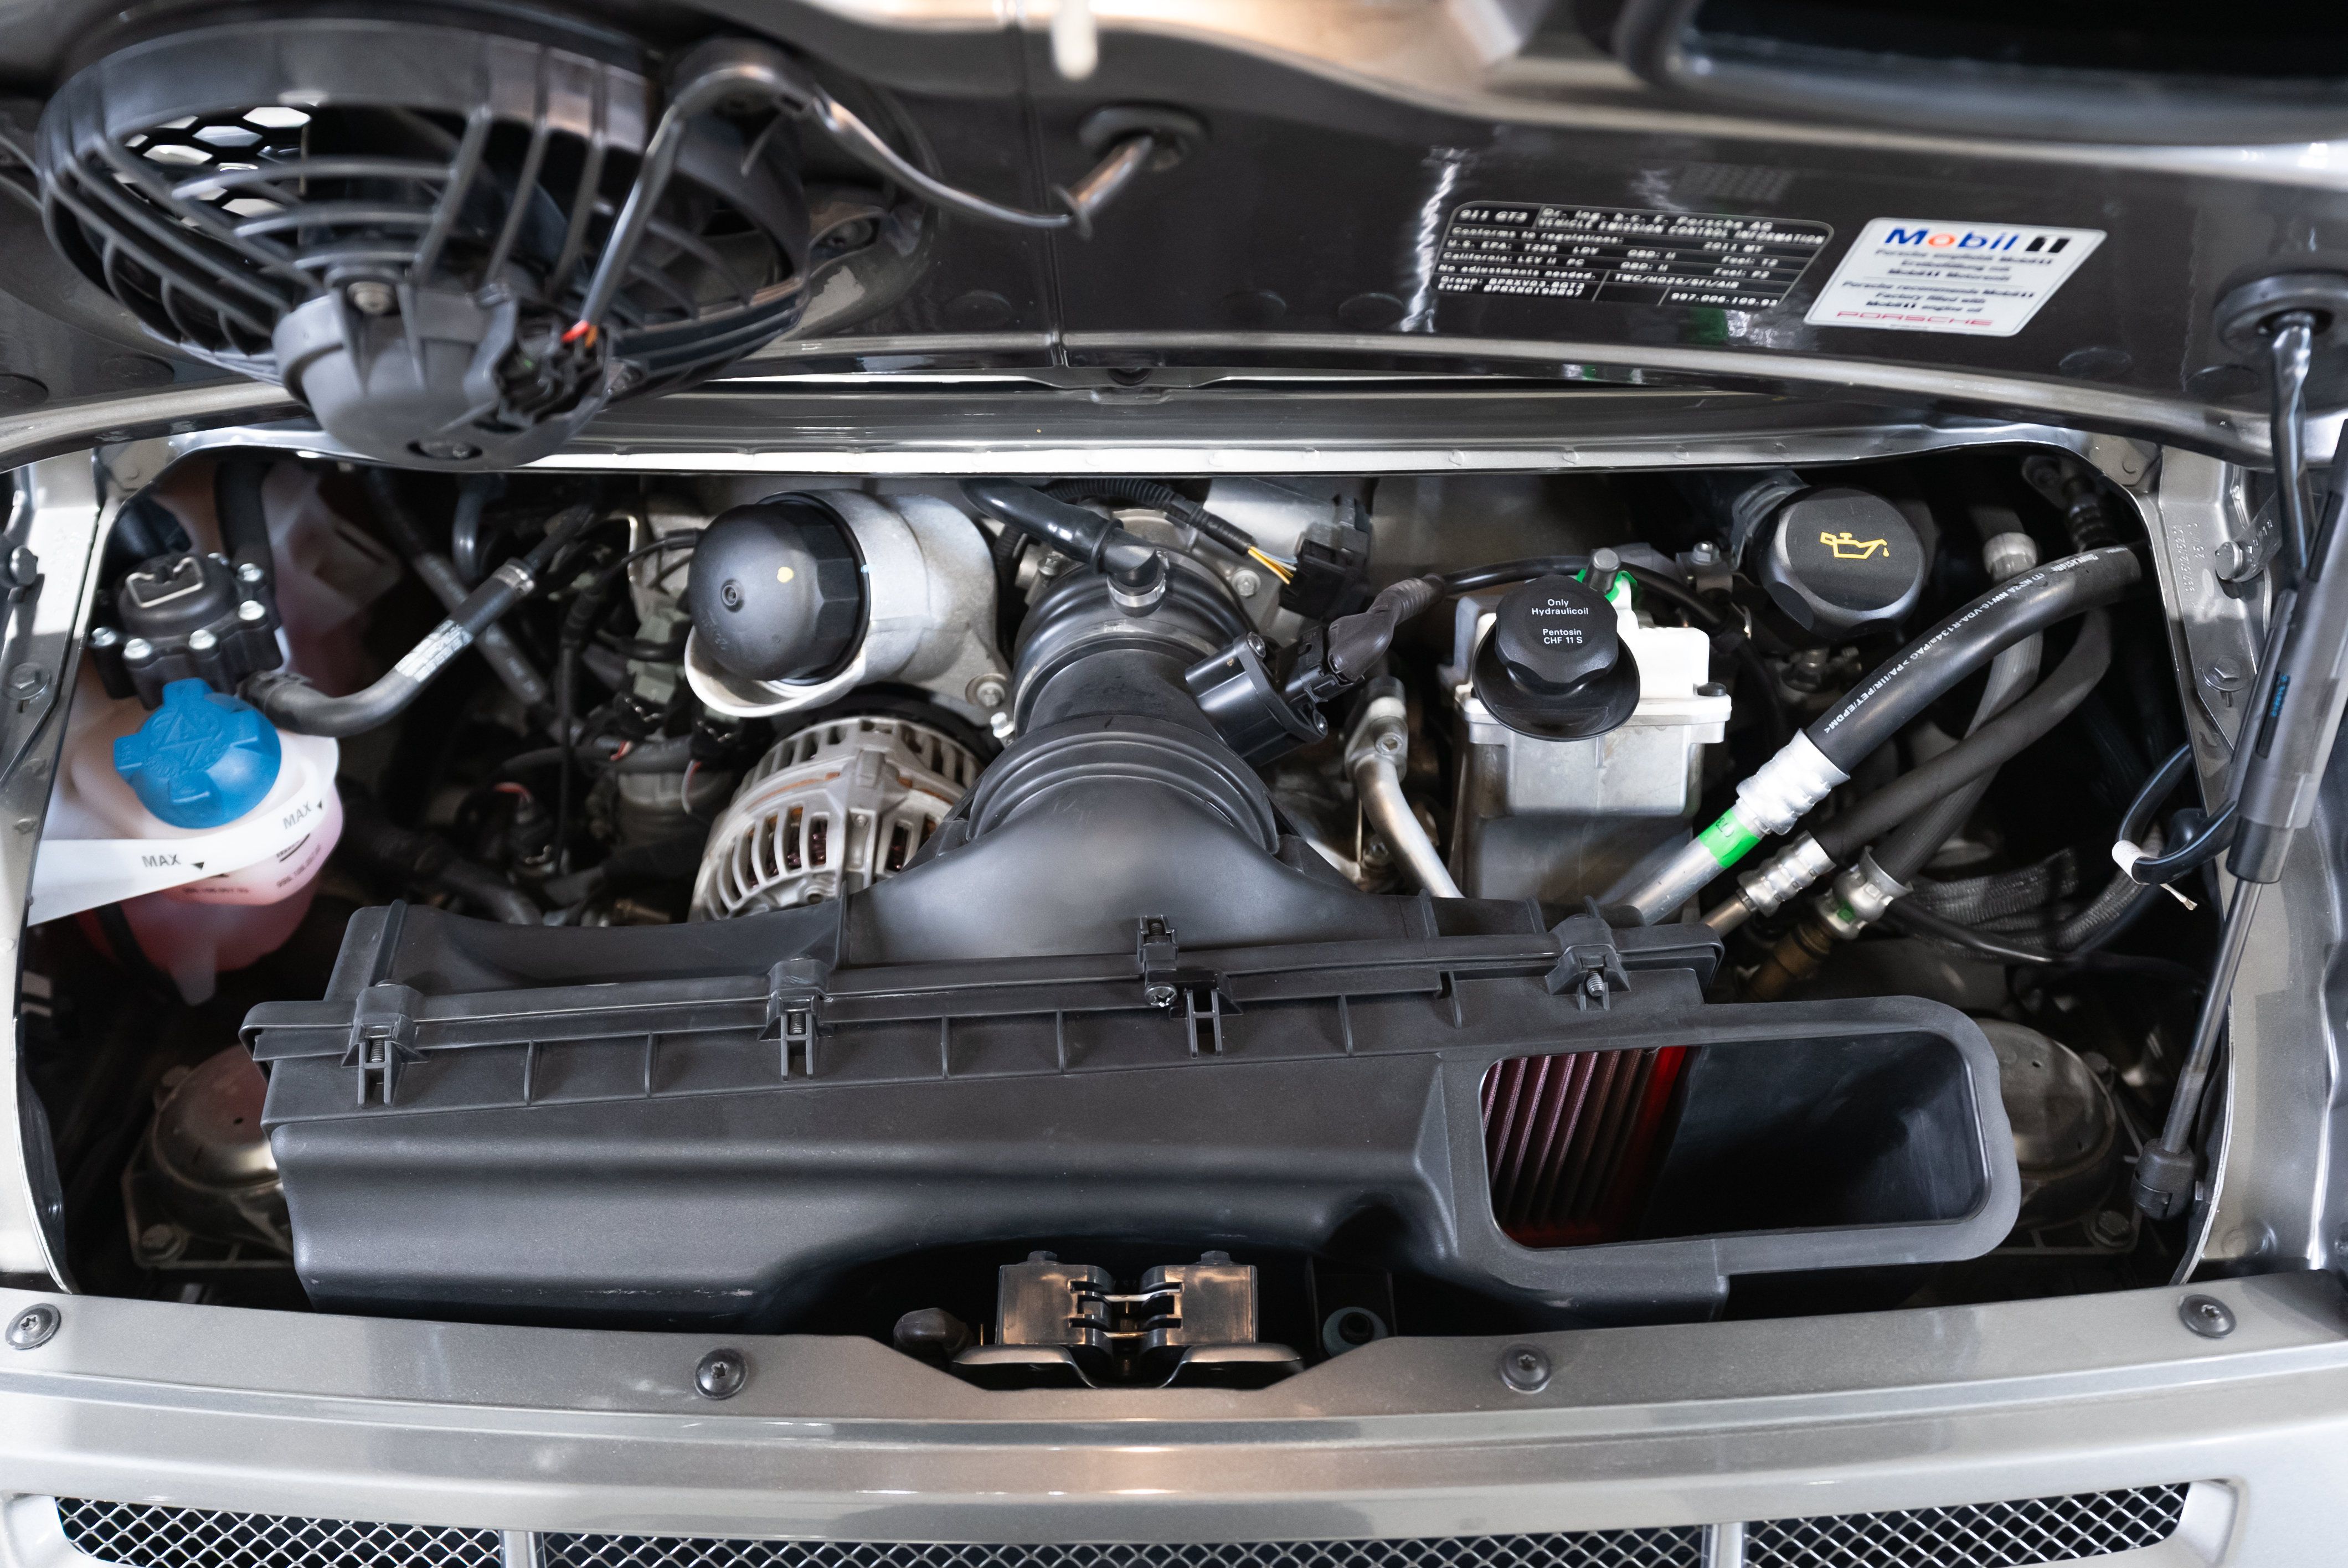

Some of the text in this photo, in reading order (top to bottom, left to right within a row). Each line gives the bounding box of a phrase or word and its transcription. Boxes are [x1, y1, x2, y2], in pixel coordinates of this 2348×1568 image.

[1459, 209, 1528, 222] 911 GT3
[1451, 226, 1516, 239] Conforms
[1521, 231, 1536, 240] to
[1538, 218, 1826, 245] VEHICLE EMISSION CONTROL INFORMATION
[1749, 221, 1773, 232] AG
[1884, 228, 2020, 250] Mobil
[1439, 264, 1456, 273] No
[1460, 265, 1539, 277] adjustments
[1837, 311, 1992, 326] PORSCHE
[1547, 599, 1569, 607] Only
[282, 803, 312, 830] MAX
[142, 854, 182, 868] MAX
